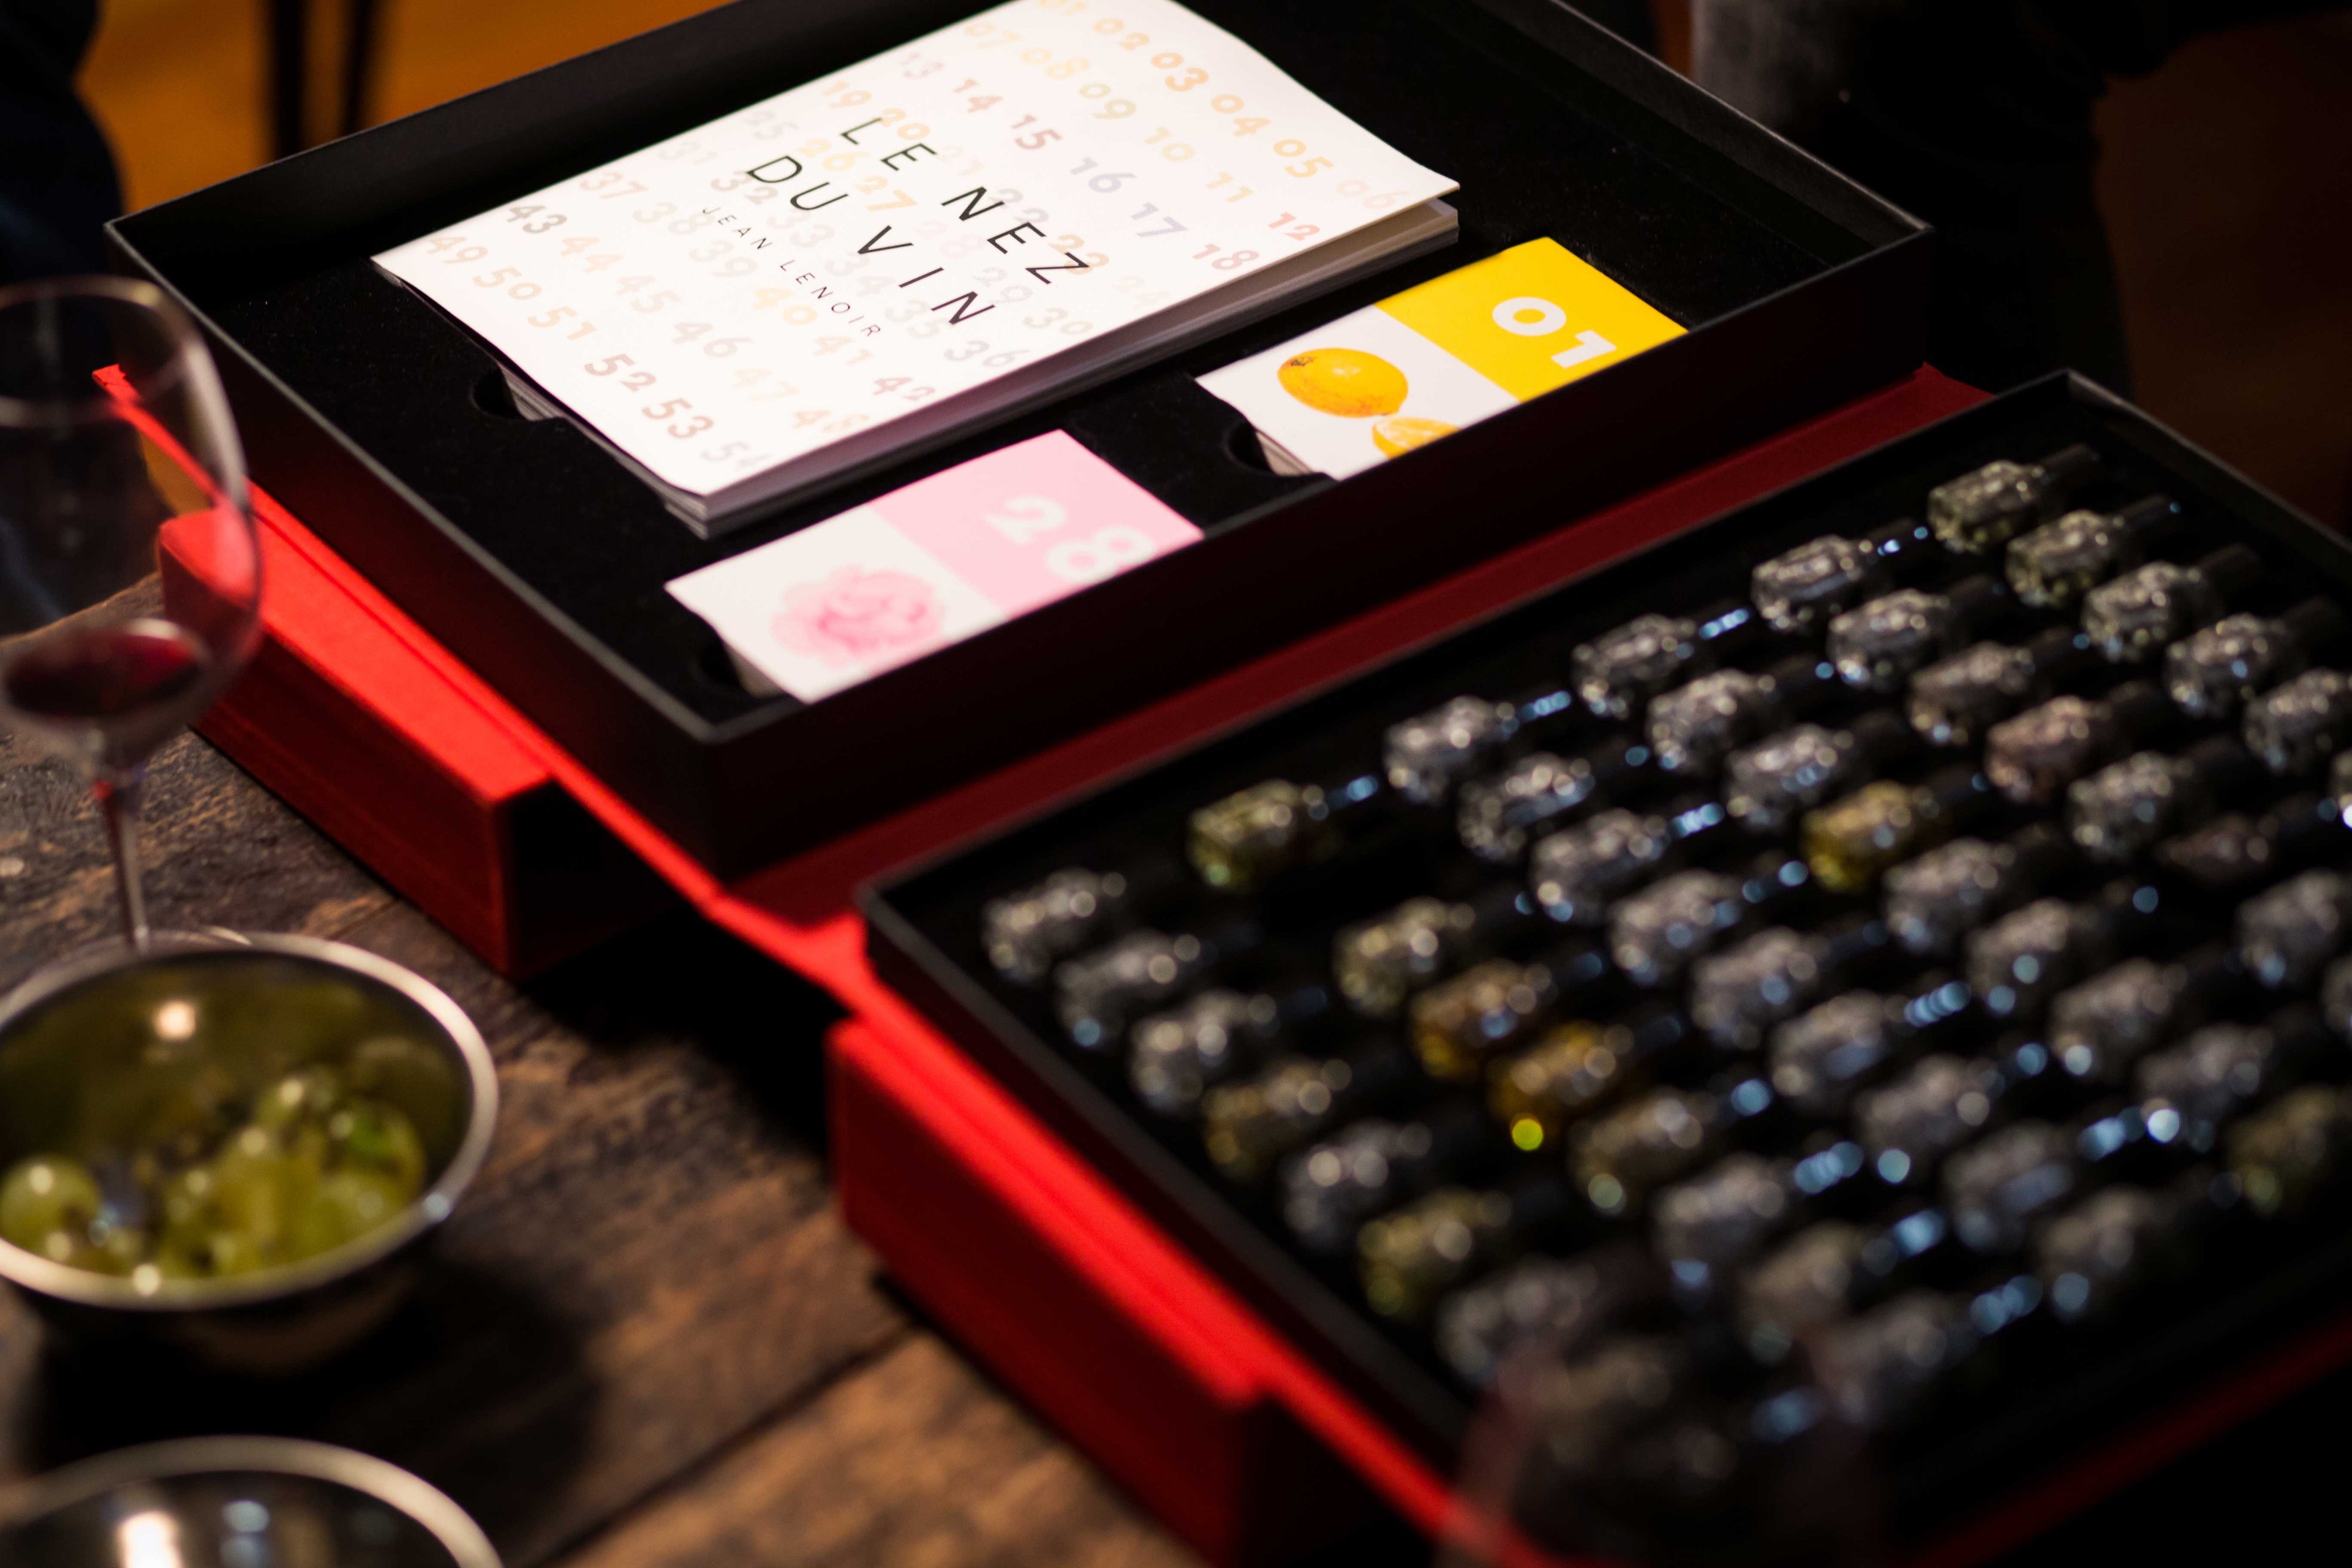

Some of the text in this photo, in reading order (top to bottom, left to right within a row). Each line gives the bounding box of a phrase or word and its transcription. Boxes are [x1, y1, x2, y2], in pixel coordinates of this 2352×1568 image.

[823, 81, 872, 108] 19
[880, 108, 930, 140] 20
[839, 117, 1091, 285] LE NEZ
[953, 78, 1003, 113] 14
[1011, 113, 1063, 151] 15
[1070, 156, 1136, 192] 16
[1130, 202, 1188, 238] 17
[1192, 243, 1259, 270] 18
[1020, 48, 1091, 80] 08
[1079, 83, 1137, 120] 09
[1144, 124, 1195, 162] 10
[1205, 172, 1254, 203] 11
[1268, 211, 1320, 241] 12
[1093, 17, 1150, 51] 02
[1151, 51, 1209, 92] 03
[1211, 93, 1272, 137] 04
[1273, 138, 1334, 178] 05
[1336, 179, 1410, 209] 06
[506, 204, 567, 233] 43
[560, 236, 624, 274] 44
[616, 275, 680, 313] 45
[673, 322, 753, 358] 46
[580, 171, 935, 401] 37 38 39 40 41 42
[702, 206, 881, 336] JEAN LENOIR
[710, 171, 778, 205] 32
[944, 340, 1031, 367] 36
[745, 155, 996, 325] DU VIN
[796, 138, 870, 172] 26
[854, 175, 918, 212] 27
[1023, 307, 1093, 335] 30
[426, 236, 488, 263] 49
[472, 266, 543, 300] 50
[527, 307, 597, 341] 51
[584, 353, 656, 391] 52
[642, 398, 714, 439] 53
[1492, 296, 1617, 369] 01
[985, 497, 1155, 581] 28
